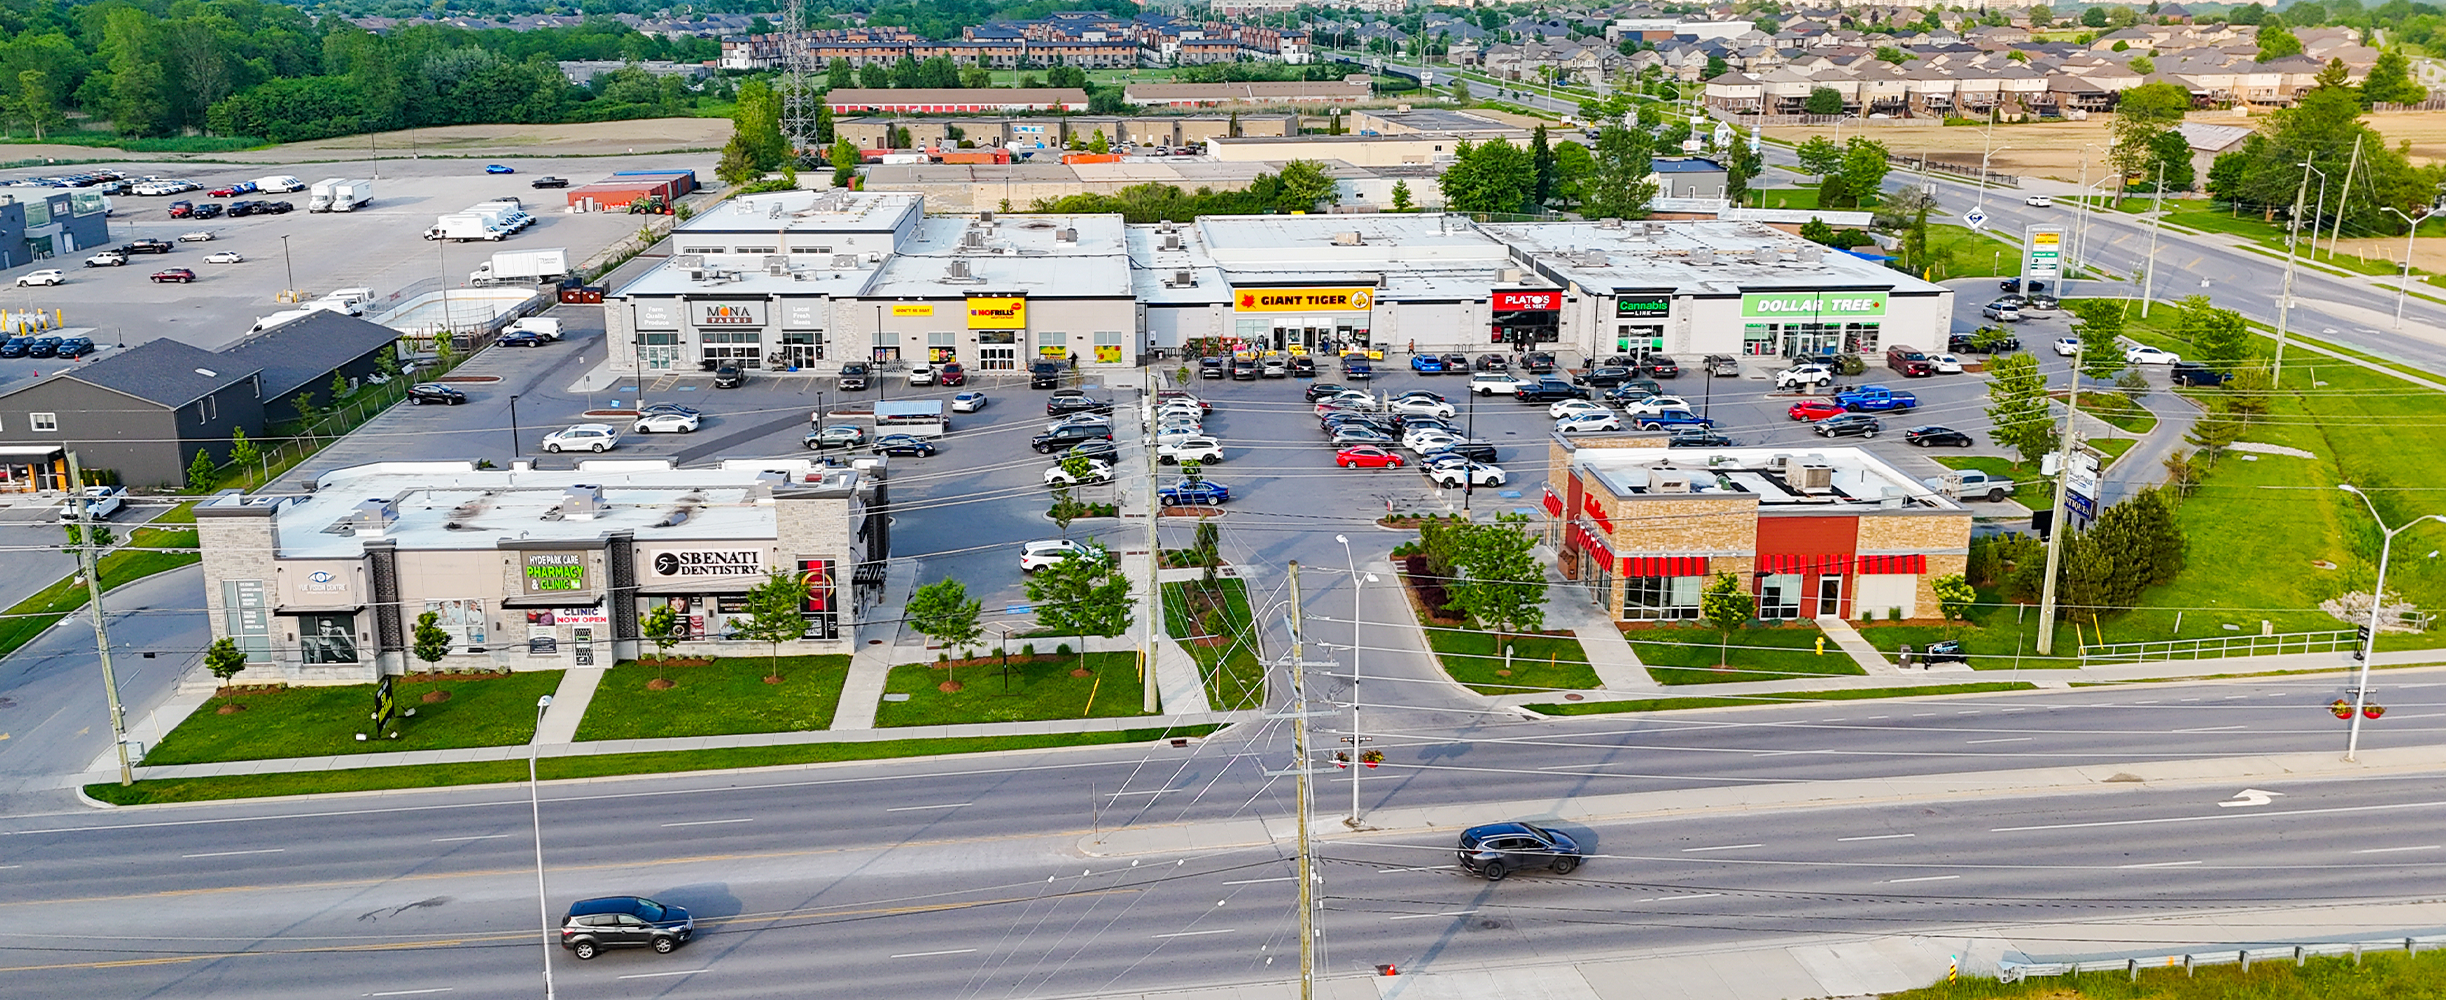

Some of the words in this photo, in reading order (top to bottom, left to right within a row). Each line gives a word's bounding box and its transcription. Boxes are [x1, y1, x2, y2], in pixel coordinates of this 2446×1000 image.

[1261, 296, 1303, 306] GIANT
[1306, 295, 1347, 305] TIGER
[1505, 295, 1550, 304] PLATO'S
[1620, 299, 1668, 310] Cannabis
[706, 304, 750, 316] MONA
[1757, 299, 1824, 312] DOLLAR
[1831, 299, 1873, 311] TREE
[529, 554, 547, 565] HYDE
[546, 554, 563, 565] PARK
[563, 554, 580, 564] CARE
[680, 551, 759, 565] SBENATI
[526, 565, 584, 578] PHARMACY
[681, 565, 759, 576] DENTISTRY
[531, 579, 539, 590] &
[540, 579, 570, 590] CLINIC
[563, 608, 599, 616] CLINIC
